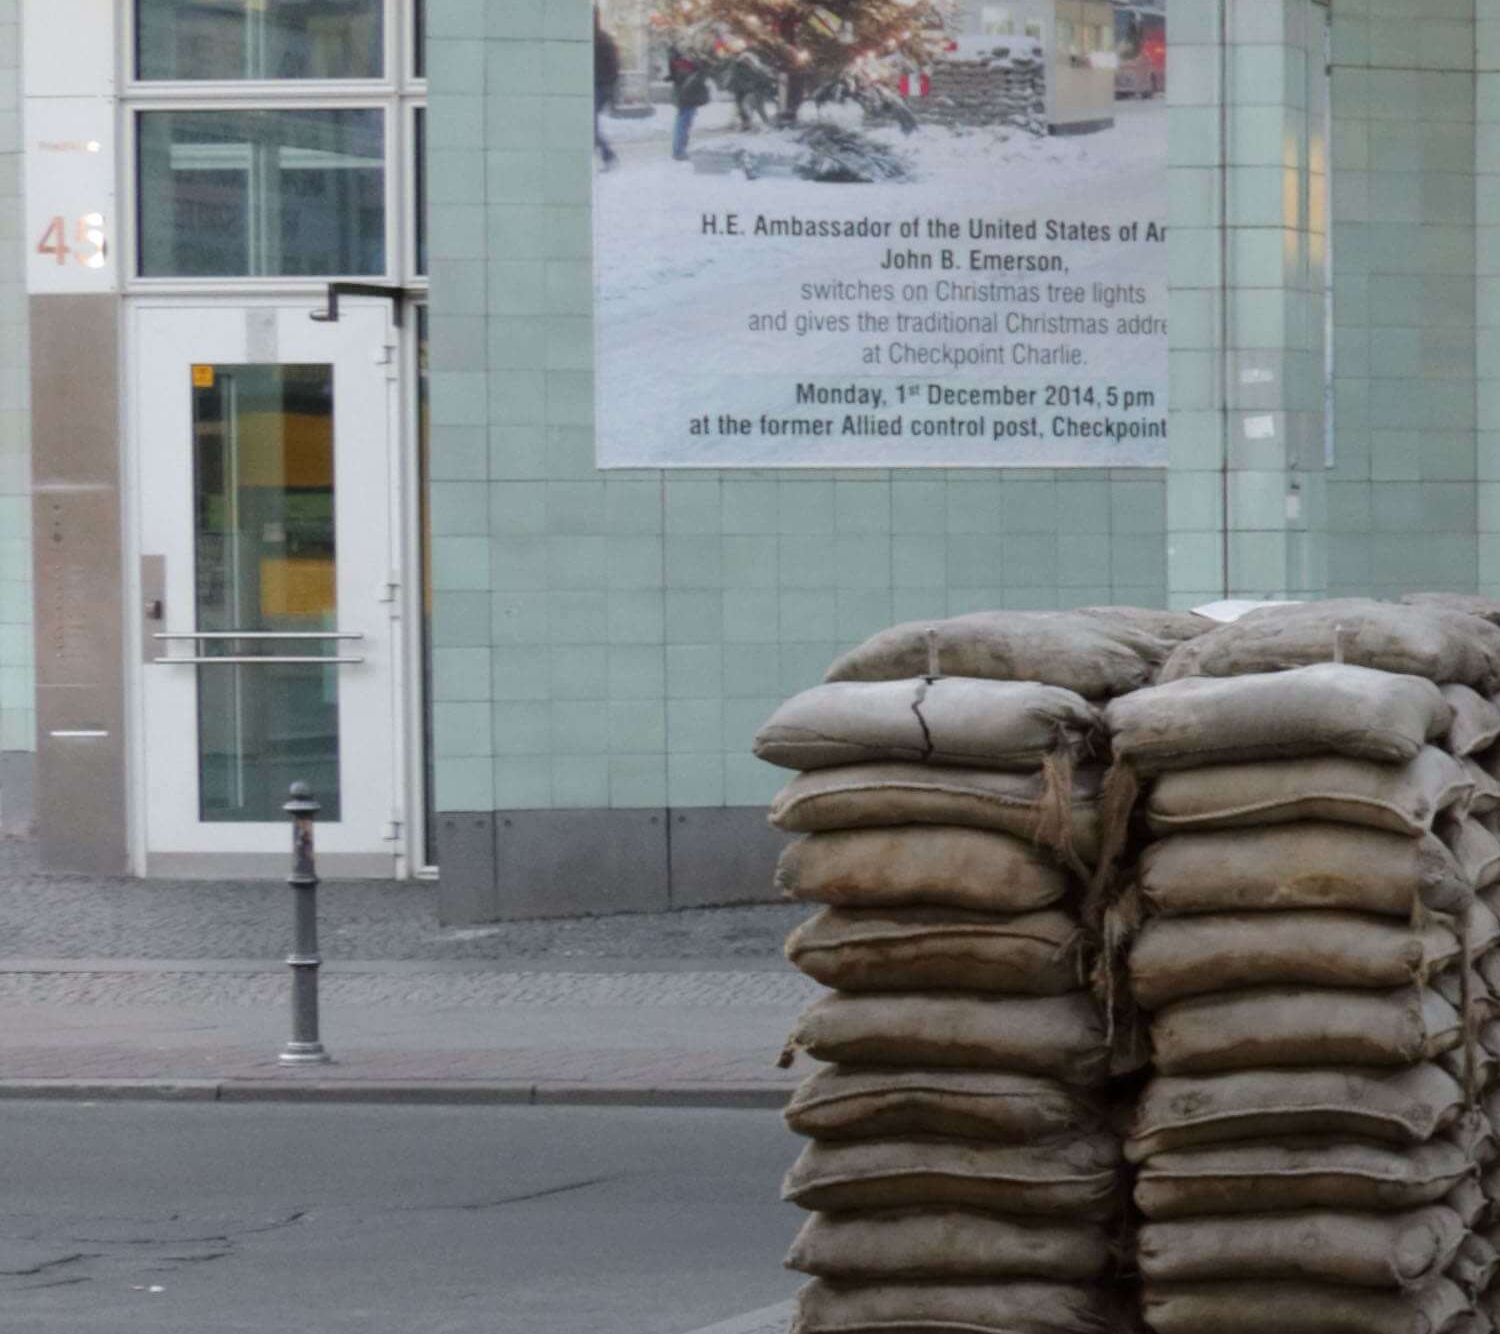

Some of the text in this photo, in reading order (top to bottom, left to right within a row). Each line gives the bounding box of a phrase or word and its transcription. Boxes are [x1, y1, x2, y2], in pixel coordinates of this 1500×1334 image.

[36, 214, 107, 268] 45
[702, 214, 744, 235] H.E.
[754, 215, 892, 237] Ambassador
[900, 217, 919, 238] of
[927, 219, 960, 239] the
[969, 219, 1036, 240] United
[1046, 219, 1110, 241] States
[1119, 222, 1137, 241] of
[881, 249, 1068, 273] John B. Emerson,
[801, 279, 1146, 308] switches on Christmas tree lights
[748, 310, 787, 331] and
[795, 311, 850, 336] gives
[857, 312, 889, 332] the
[897, 312, 997, 333] traditional
[1006, 312, 1108, 334] Christmas
[862, 342, 1086, 369] at Checkpoint Charlie.
[796, 383, 886, 409] Monday,
[928, 384, 1037, 406] December
[1045, 385, 1100, 407] 2014,
[1107, 386, 1118, 406] 5
[1124, 391, 1154, 411] pm
[690, 415, 1166, 443] at the former Allied control post, Checkpoint
